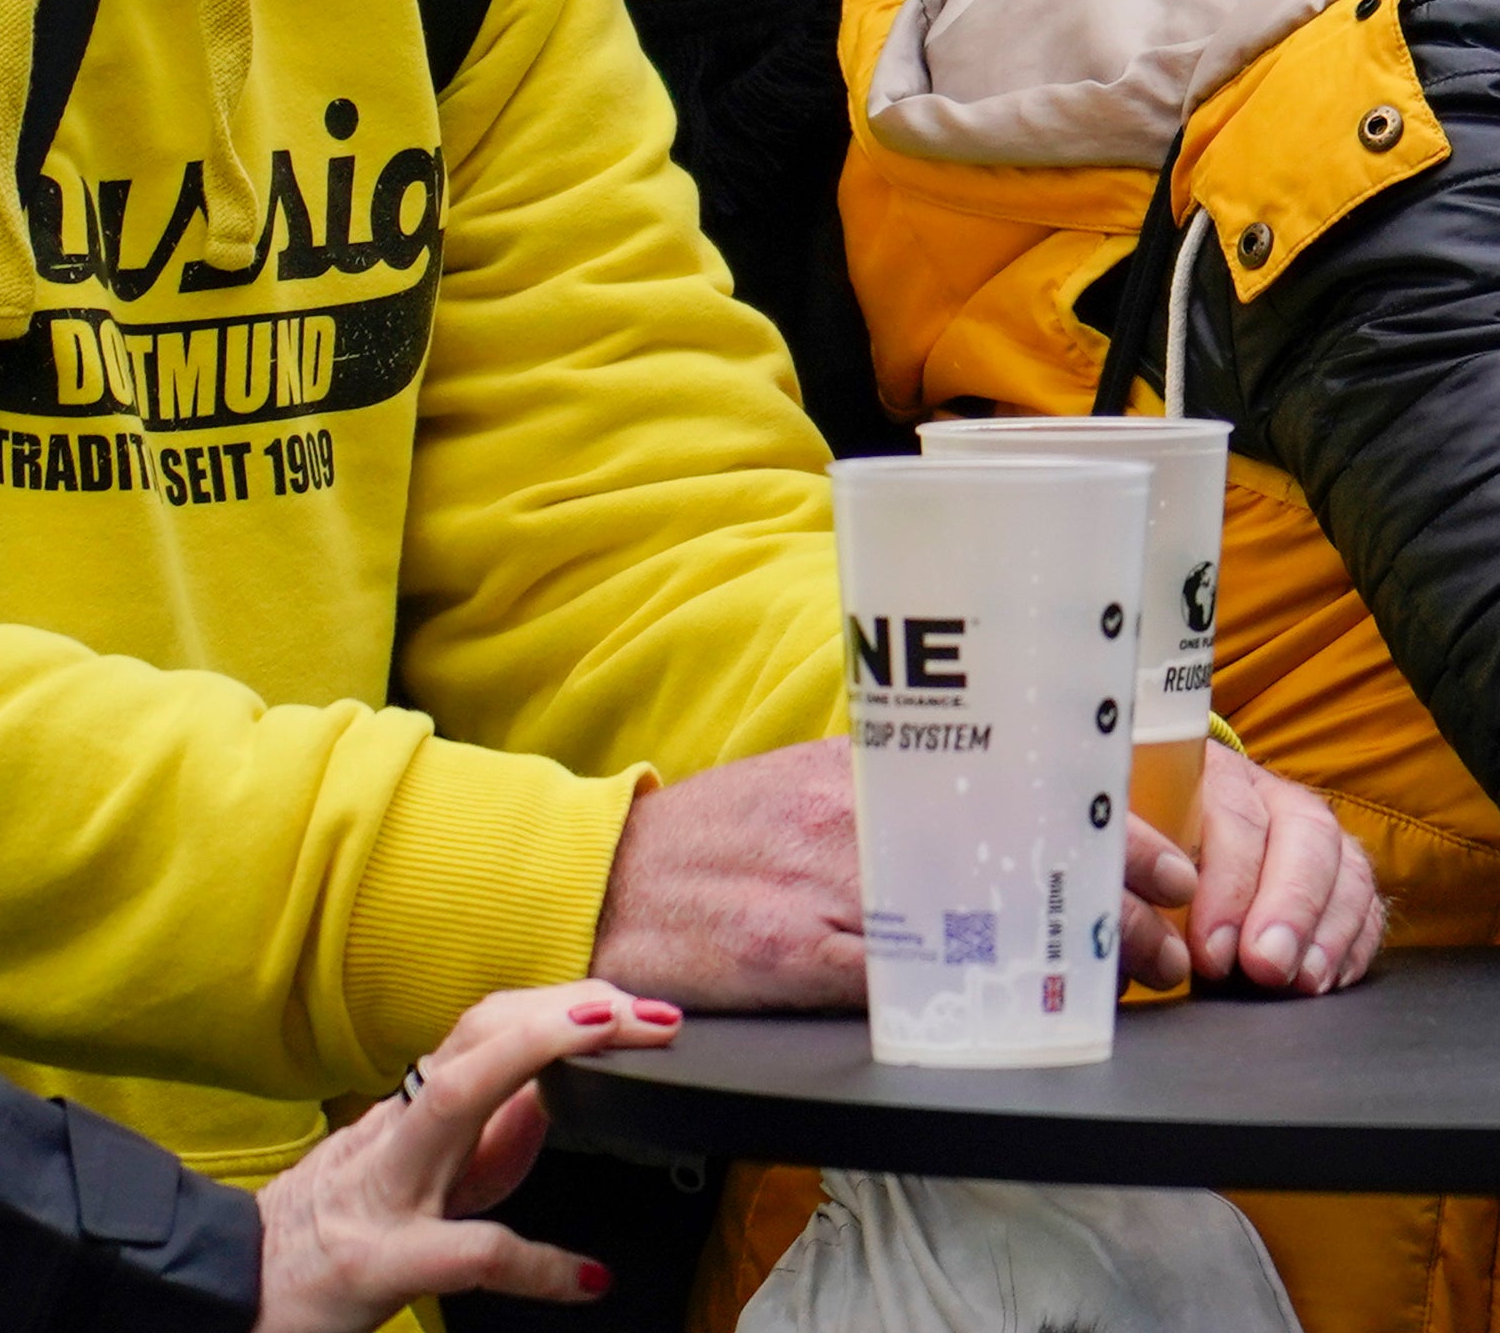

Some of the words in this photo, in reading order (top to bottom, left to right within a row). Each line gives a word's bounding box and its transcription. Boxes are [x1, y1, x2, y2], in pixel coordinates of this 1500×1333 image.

[49, 314, 337, 421] DOTMUND
[159, 441, 252, 507] SEIT
[264, 429, 336, 496] 1909
[864, 720, 895, 749] CUP
[899, 722, 993, 752] SYSTEM
